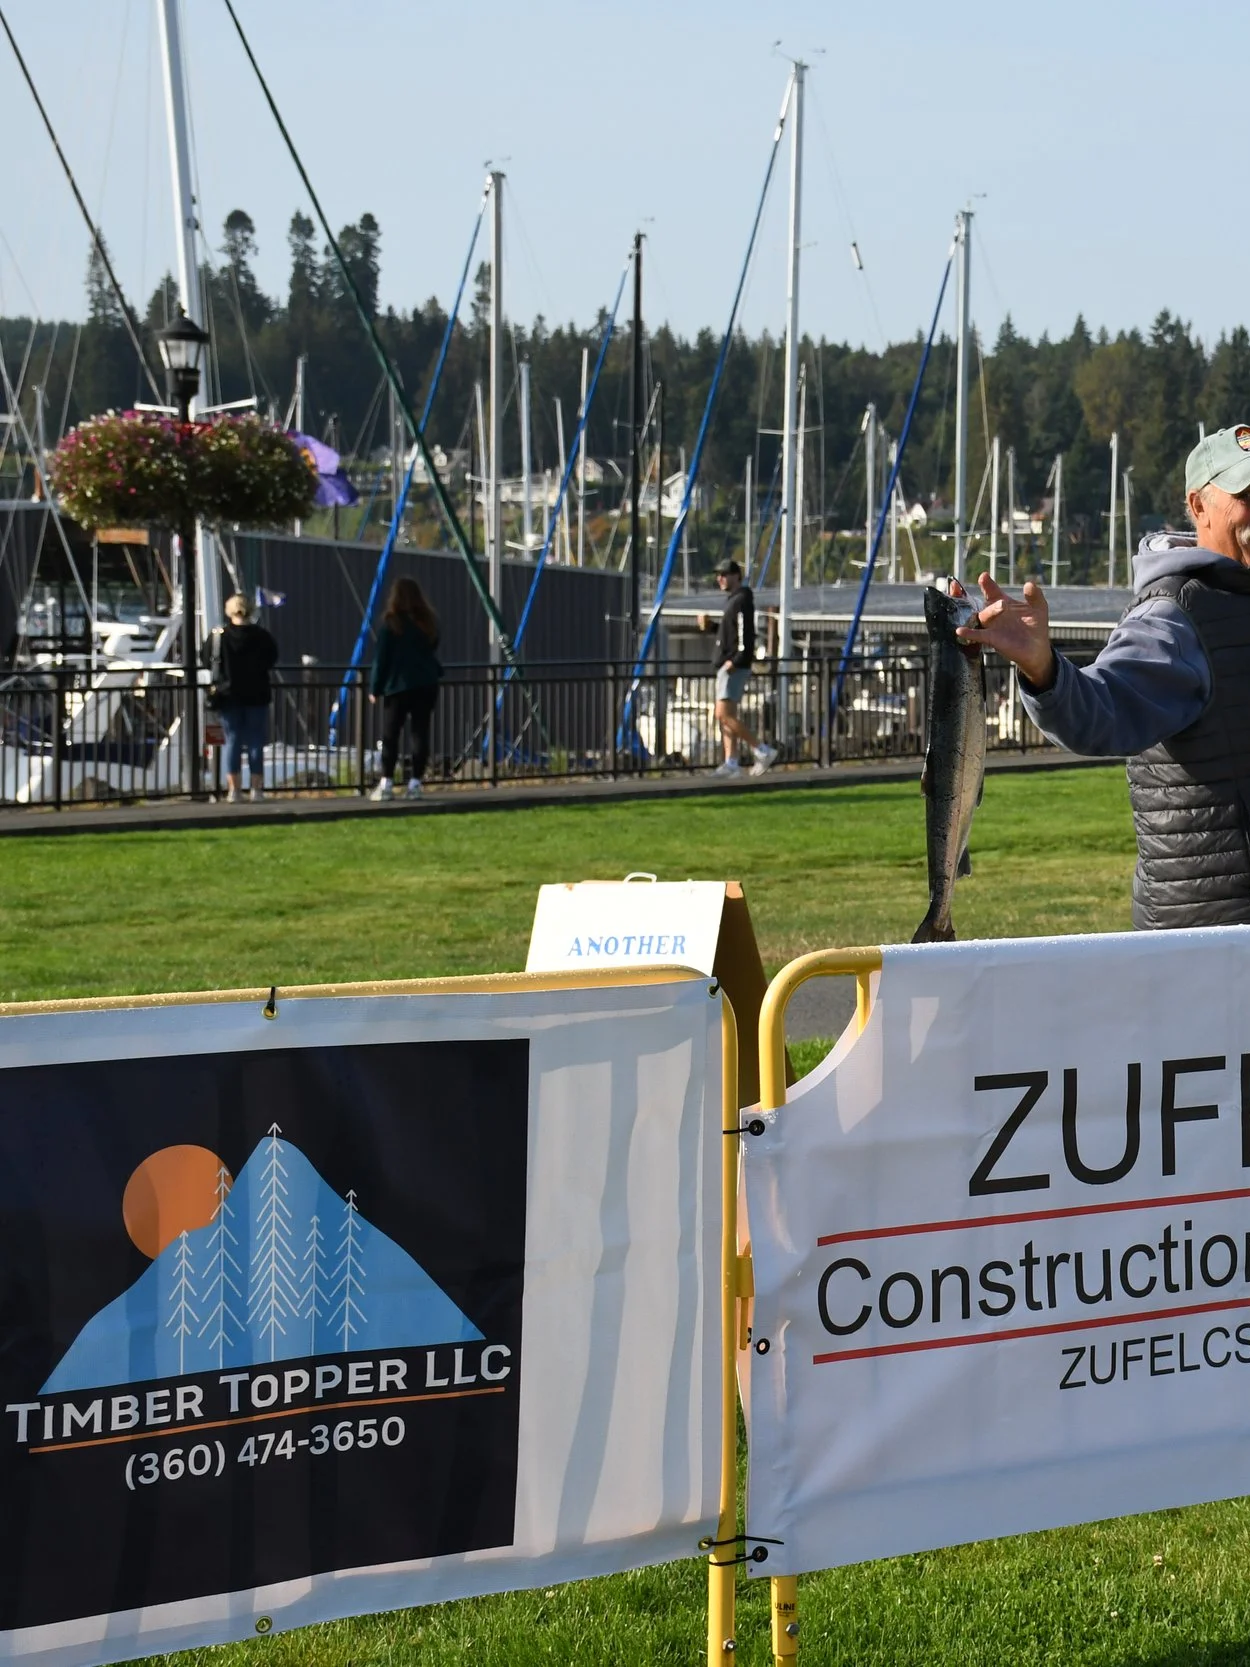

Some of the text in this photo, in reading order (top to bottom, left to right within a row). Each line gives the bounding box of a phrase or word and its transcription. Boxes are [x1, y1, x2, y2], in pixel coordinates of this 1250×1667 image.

[568, 935, 686, 956] ANOTHER
[6, 1343, 513, 1444] TIMBER TOPPER LLC
[124, 1415, 407, 1491] (360) 474-3650
